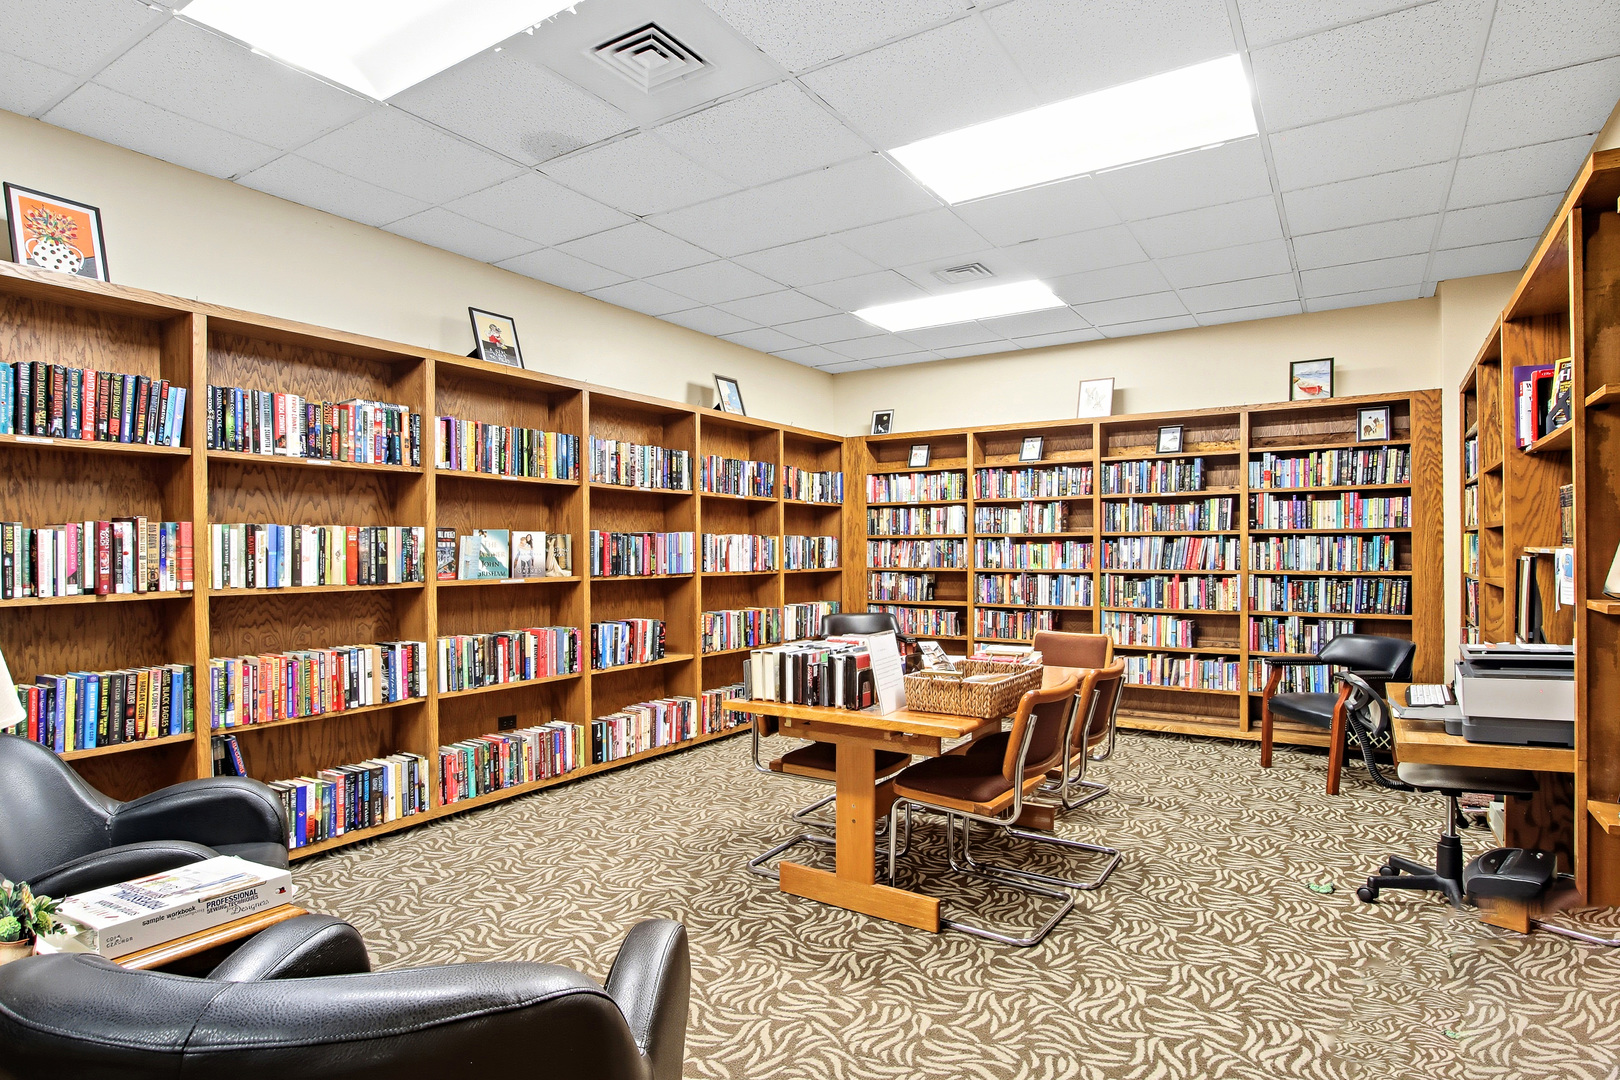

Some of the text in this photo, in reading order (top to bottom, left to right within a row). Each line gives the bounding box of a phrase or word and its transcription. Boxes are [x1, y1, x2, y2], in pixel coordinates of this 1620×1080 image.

[37, 364, 45, 380] DAVID
[54, 374, 63, 390] DAVID
[86, 371, 95, 390] DAVID
[37, 382, 45, 408] BALDACCI
[100, 380, 108, 394] DAVID
[54, 391, 63, 417] BALDACCI
[86, 390, 95, 421] BALDACCI
[100, 395, 108, 419] BALDACCI
[112, 395, 120, 418] BALDACCI
[206, 888, 258, 908] PROFESSIONAL
[207, 894, 259, 914] SEWING TECHNIQUES
[142, 905, 196, 926] sample workbook
